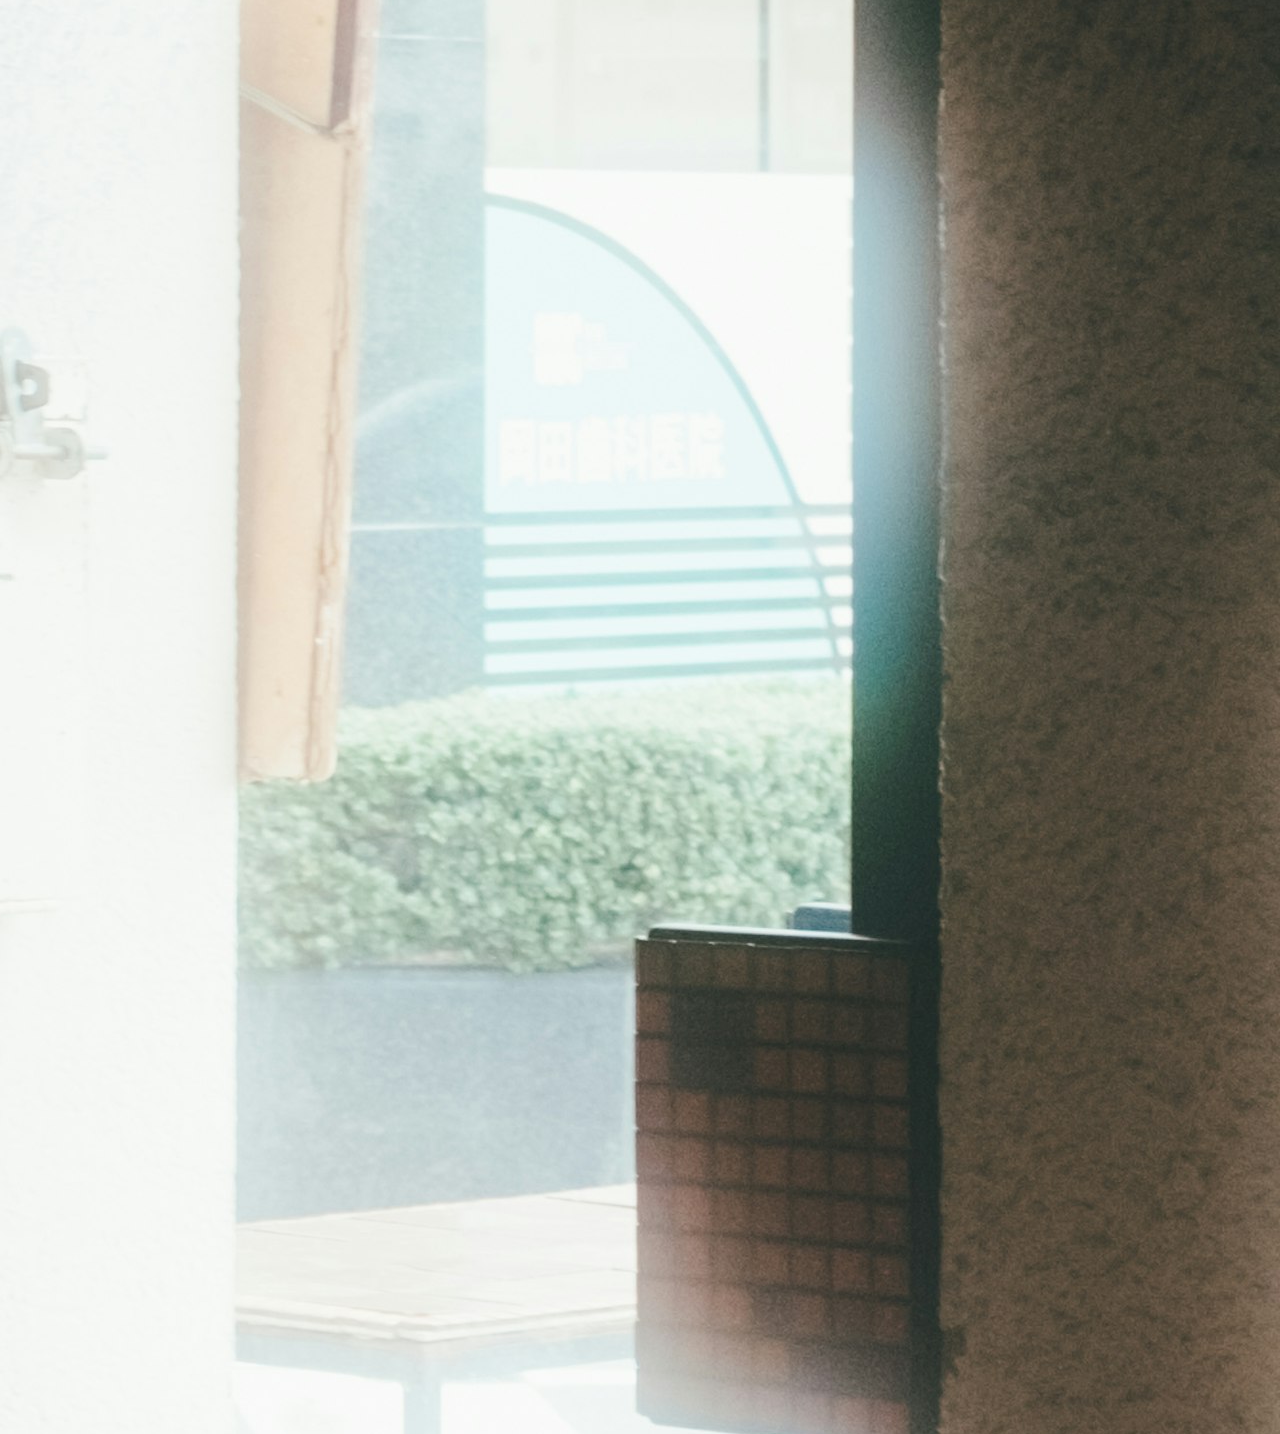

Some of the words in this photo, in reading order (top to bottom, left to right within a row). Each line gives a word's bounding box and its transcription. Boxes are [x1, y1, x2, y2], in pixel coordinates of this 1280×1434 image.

[499, 413, 726, 486] 岡田歯科医院
